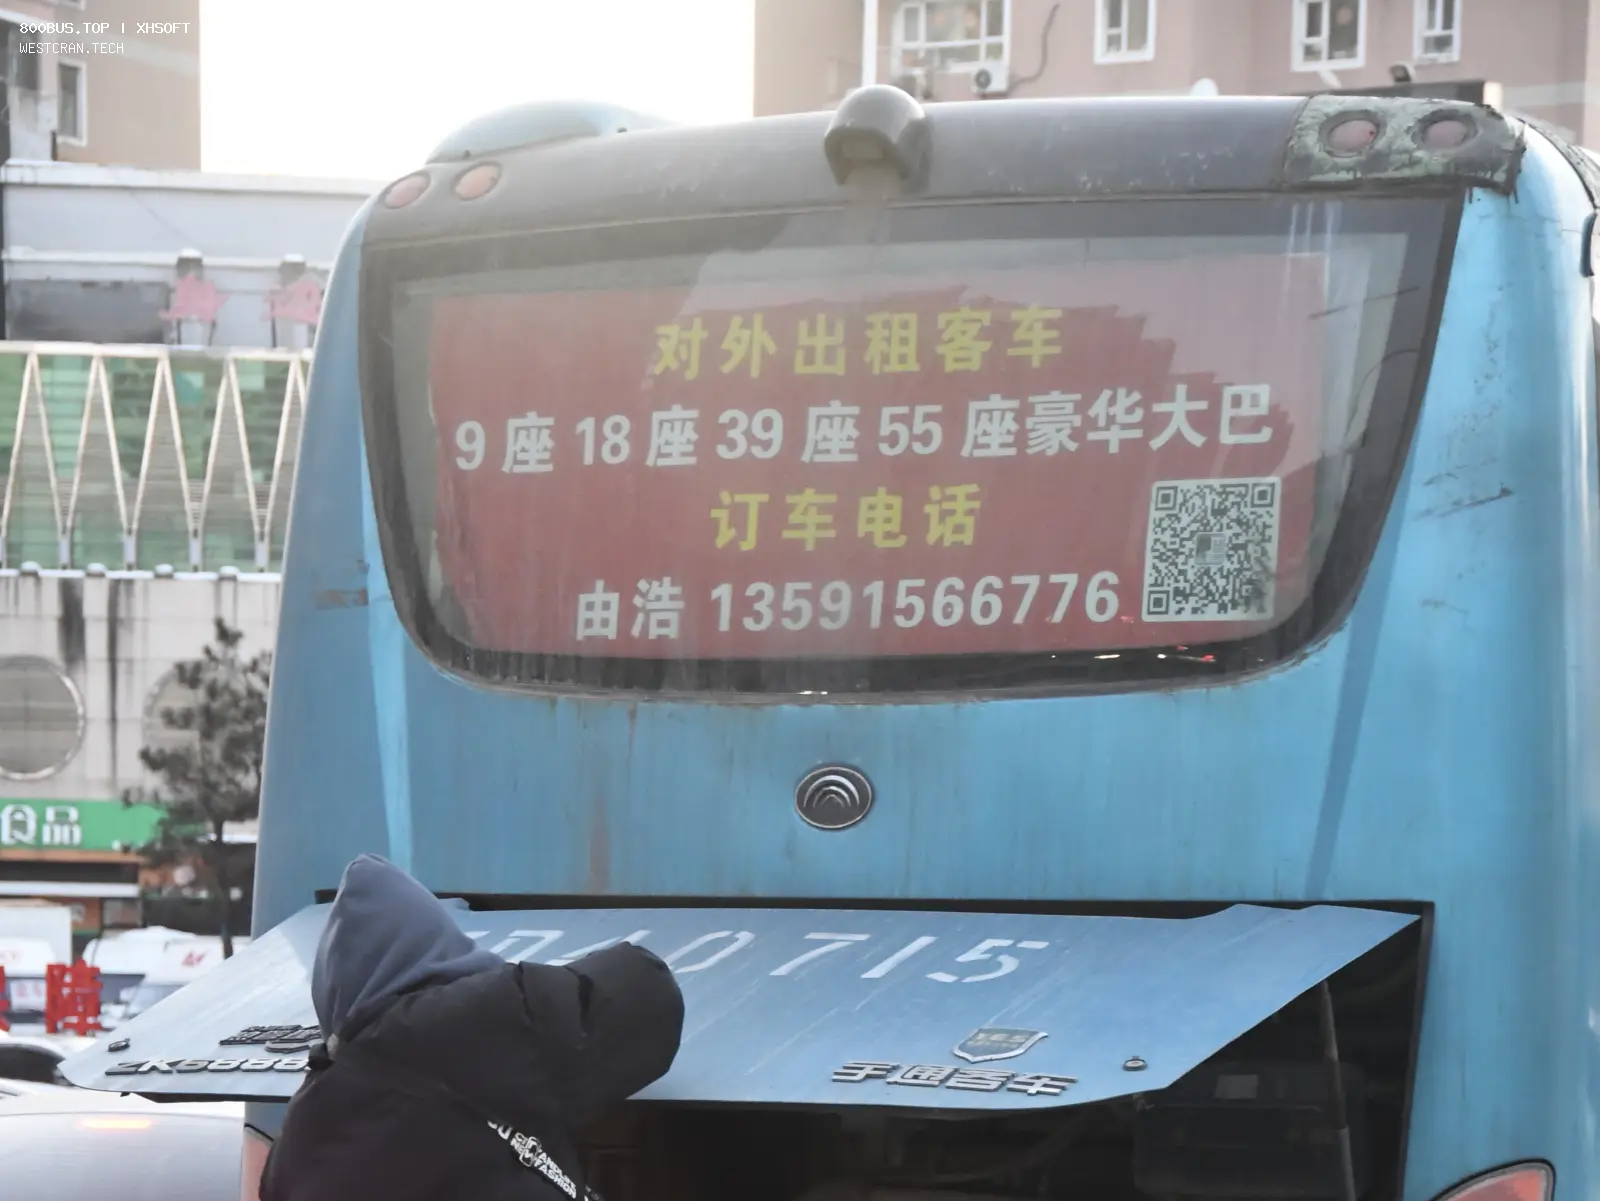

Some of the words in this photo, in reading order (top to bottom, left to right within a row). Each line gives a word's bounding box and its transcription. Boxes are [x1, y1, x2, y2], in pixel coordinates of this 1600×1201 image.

[653, 303, 1063, 380] 对外出租客车
[711, 483, 981, 551] 订车电话
[832, 1060, 1079, 1096] 宇通客车
